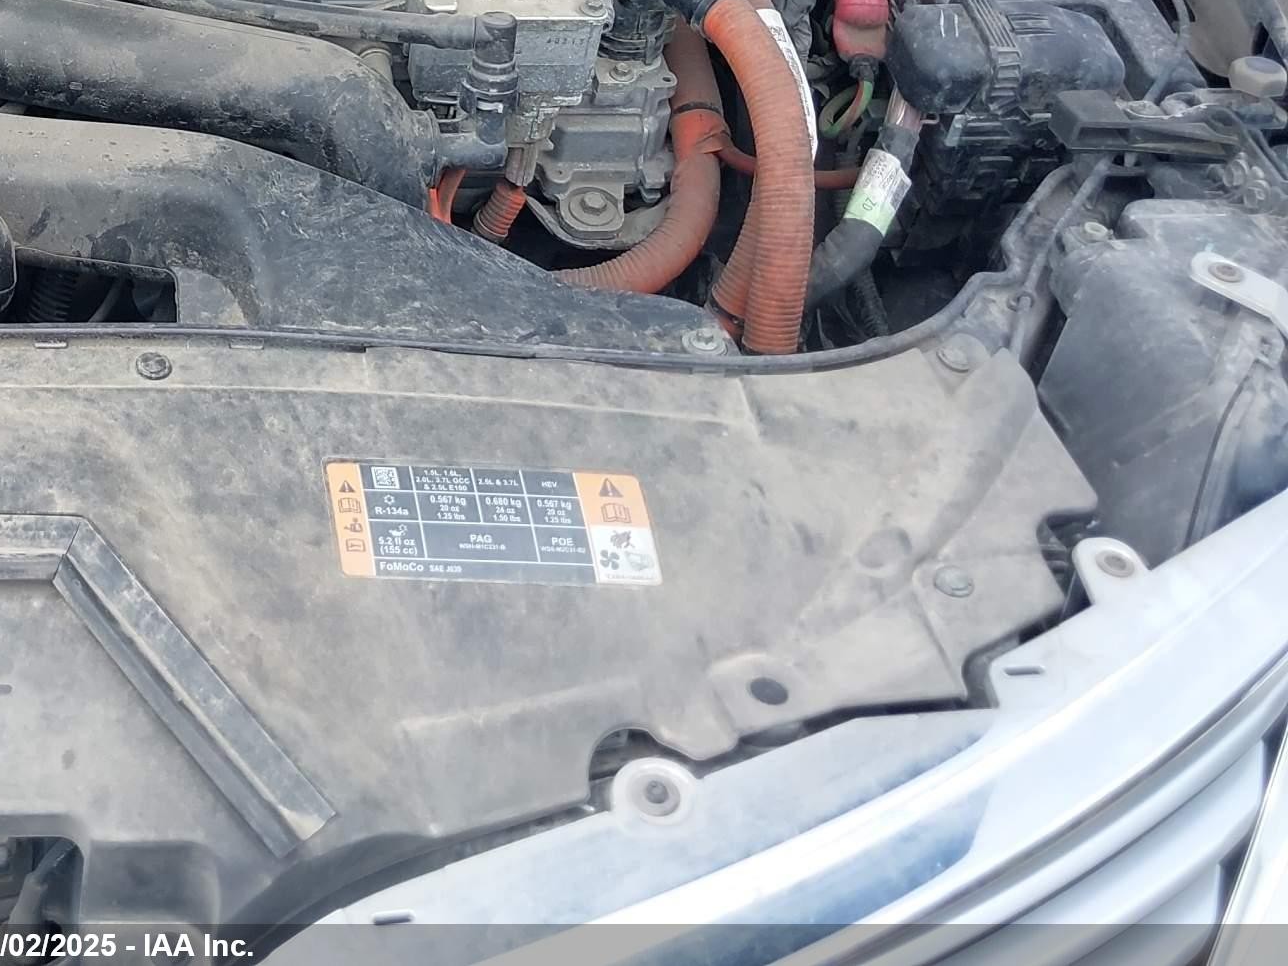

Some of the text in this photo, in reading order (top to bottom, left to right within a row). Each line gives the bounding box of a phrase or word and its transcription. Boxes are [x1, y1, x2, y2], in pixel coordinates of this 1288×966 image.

[455, 495, 466, 506] kg
[510, 497, 522, 508] kg
[374, 506, 409, 515] R-134a
[378, 536, 393, 545] 5.2
[403, 538, 416, 546] oz
[470, 533, 493, 543] PAG
[551, 536, 575, 546] POE
[403, 546, 418, 556] cc)
[379, 561, 424, 572] FoMoCo
[429, 564, 444, 572] SAE
